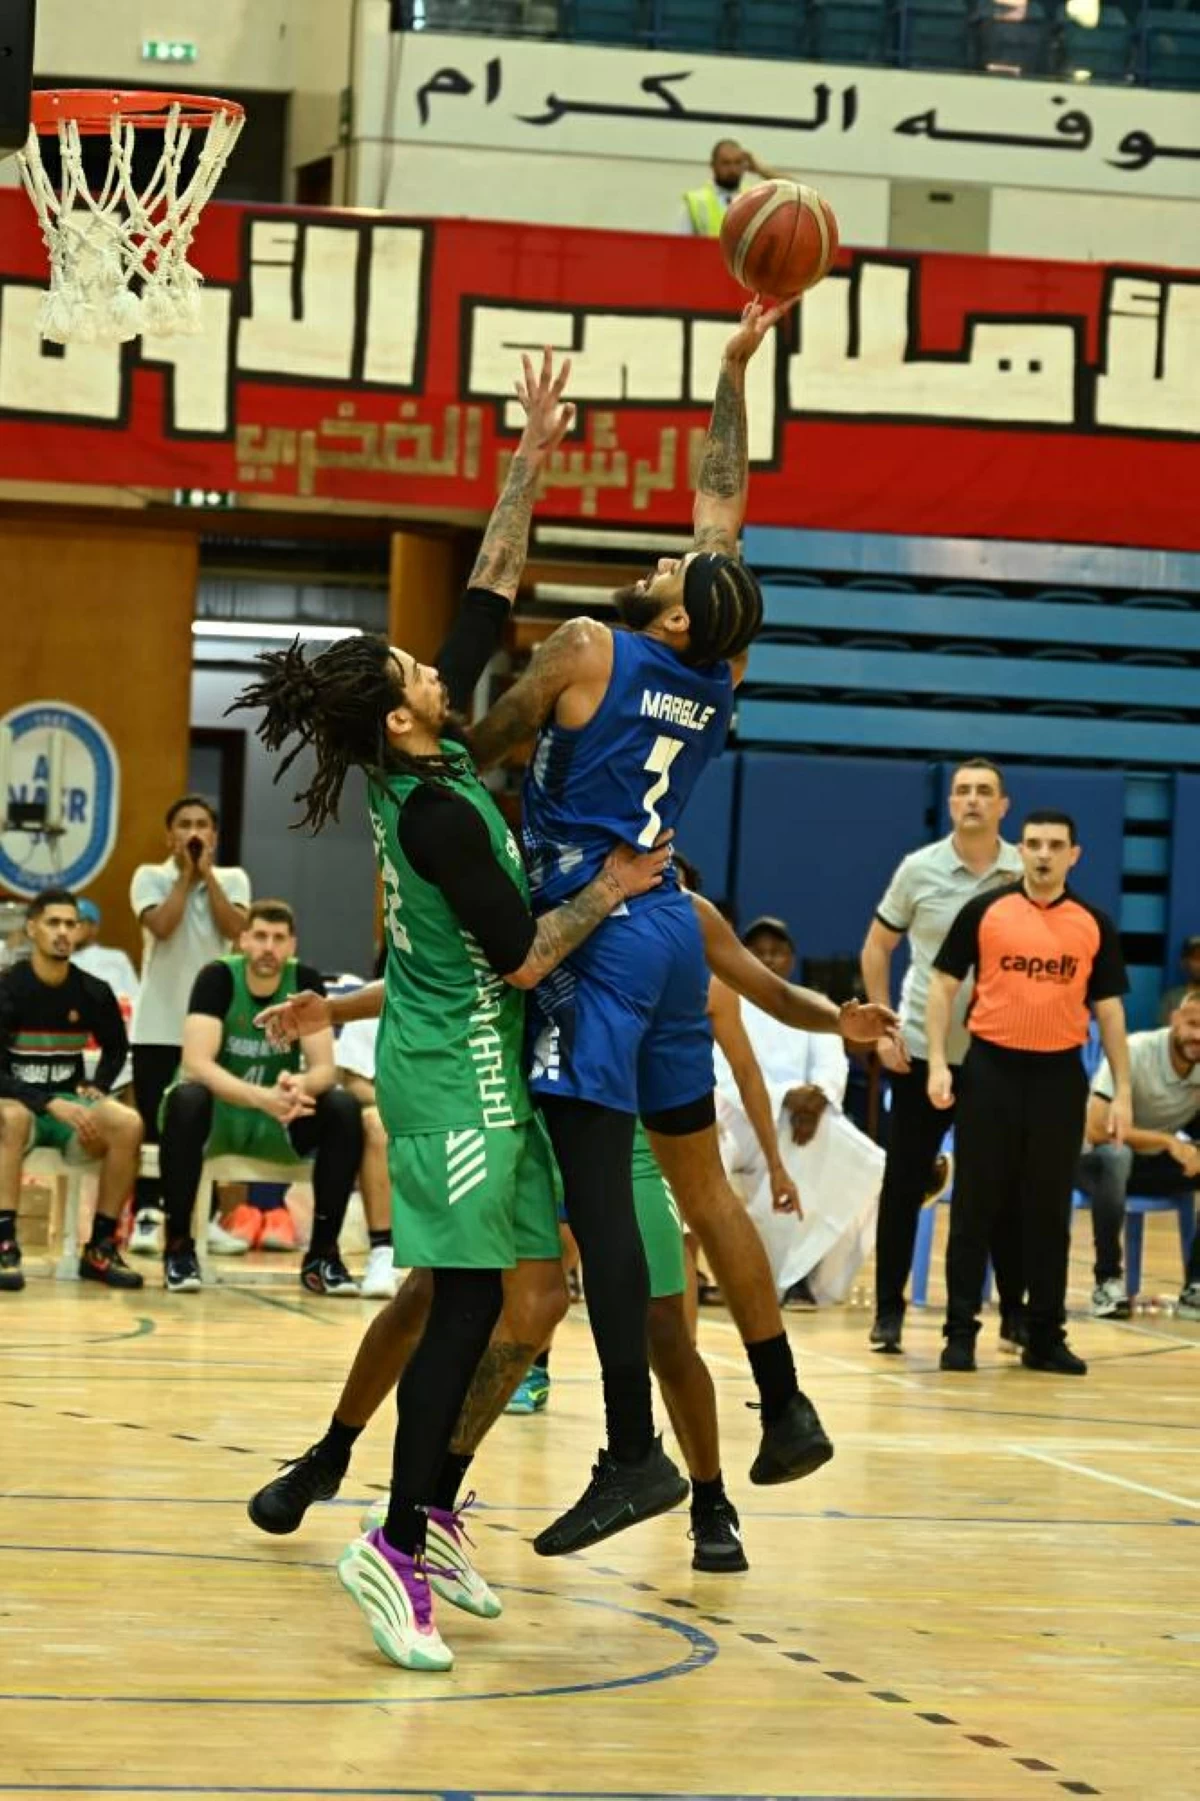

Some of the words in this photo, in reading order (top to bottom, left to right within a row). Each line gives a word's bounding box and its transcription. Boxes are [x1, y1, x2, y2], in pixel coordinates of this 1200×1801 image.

[415, 58, 858, 132] الكرام
[893, 96, 1200, 169] وفه
[235, 402, 482, 496] الفخري
[639, 689, 717, 731] MARBLE
[637, 734, 687, 848] 7
